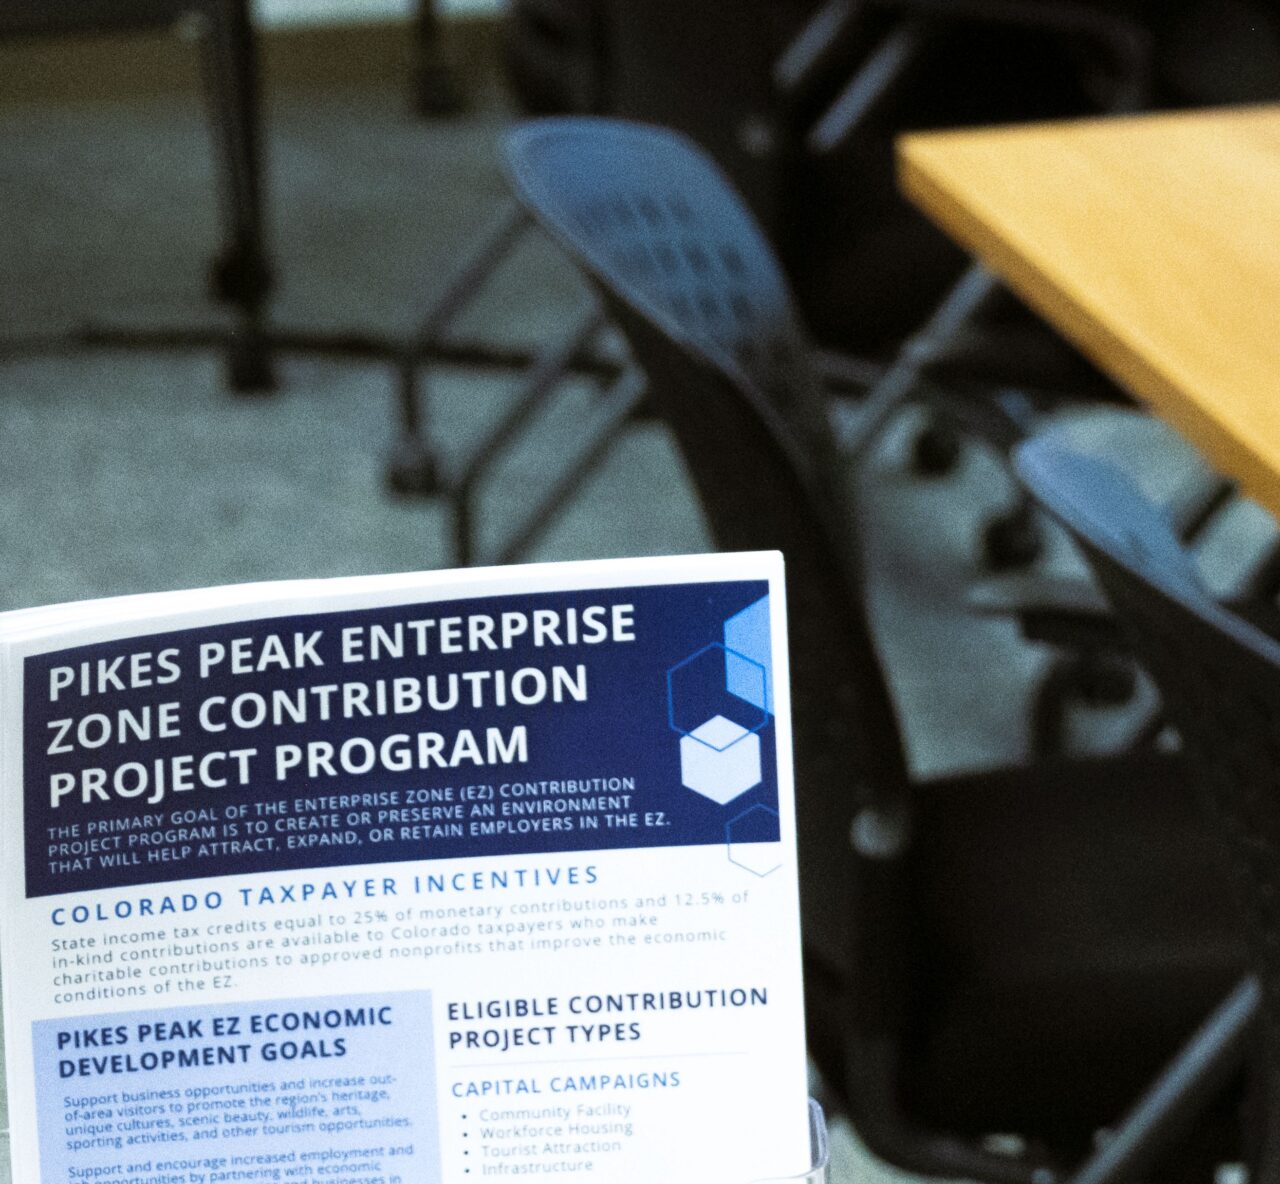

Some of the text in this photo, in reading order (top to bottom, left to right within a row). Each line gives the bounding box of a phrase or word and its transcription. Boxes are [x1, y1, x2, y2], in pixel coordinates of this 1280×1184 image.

[49, 603, 635, 701] PIKES PEAK ENTERPRISE
[46, 663, 587, 755] ZONE CONTRIBUTION
[49, 724, 528, 808] PROJECT PROGRAM
[47, 776, 635, 839] THE PRIMARY GOAL OF THE ENTERPRISE ZONE (EZ) CONTRIBUTION
[47, 794, 631, 857] PROJECT PROGRAM IS TO CREATE OR PRESERVE AN ENVIRONMENT
[48, 811, 670, 873] THAT WILL HELP ATTRACT, EXPAND, OR RETAIN EMPLOYERS IN THE EZ.
[50, 865, 597, 926] COLORADO TAXPAYER INCENTIVES
[51, 888, 748, 953] State income tax credits equal to 25% of monetary contributions and 12.5% of
[51, 914, 657, 969] in-kind contributions are available to Colorado taxpayers who make
[52, 930, 725, 987] charitable contributions to approved nonprofits that improve the economic
[53, 975, 238, 1003] conditions of the EZ.
[447, 987, 767, 1021] ELIGIBLE CONTRIBUTION
[56, 1005, 392, 1050] PIKES PEAK EZ ECONOMIC
[449, 1021, 640, 1052] PROJECT TYPES
[58, 1037, 346, 1079] DEVELOPMENT GOALS
[62, 1074, 396, 1109] Support business opportunities and increase out-
[451, 1070, 680, 1098] CAPITAL CAMPAIGNS
[478, 1103, 631, 1122] Community Facility
[479, 1122, 633, 1139] Workforce Housing
[480, 1141, 621, 1158] Tourist Attraction
[481, 1160, 593, 1175] Infrastructure
